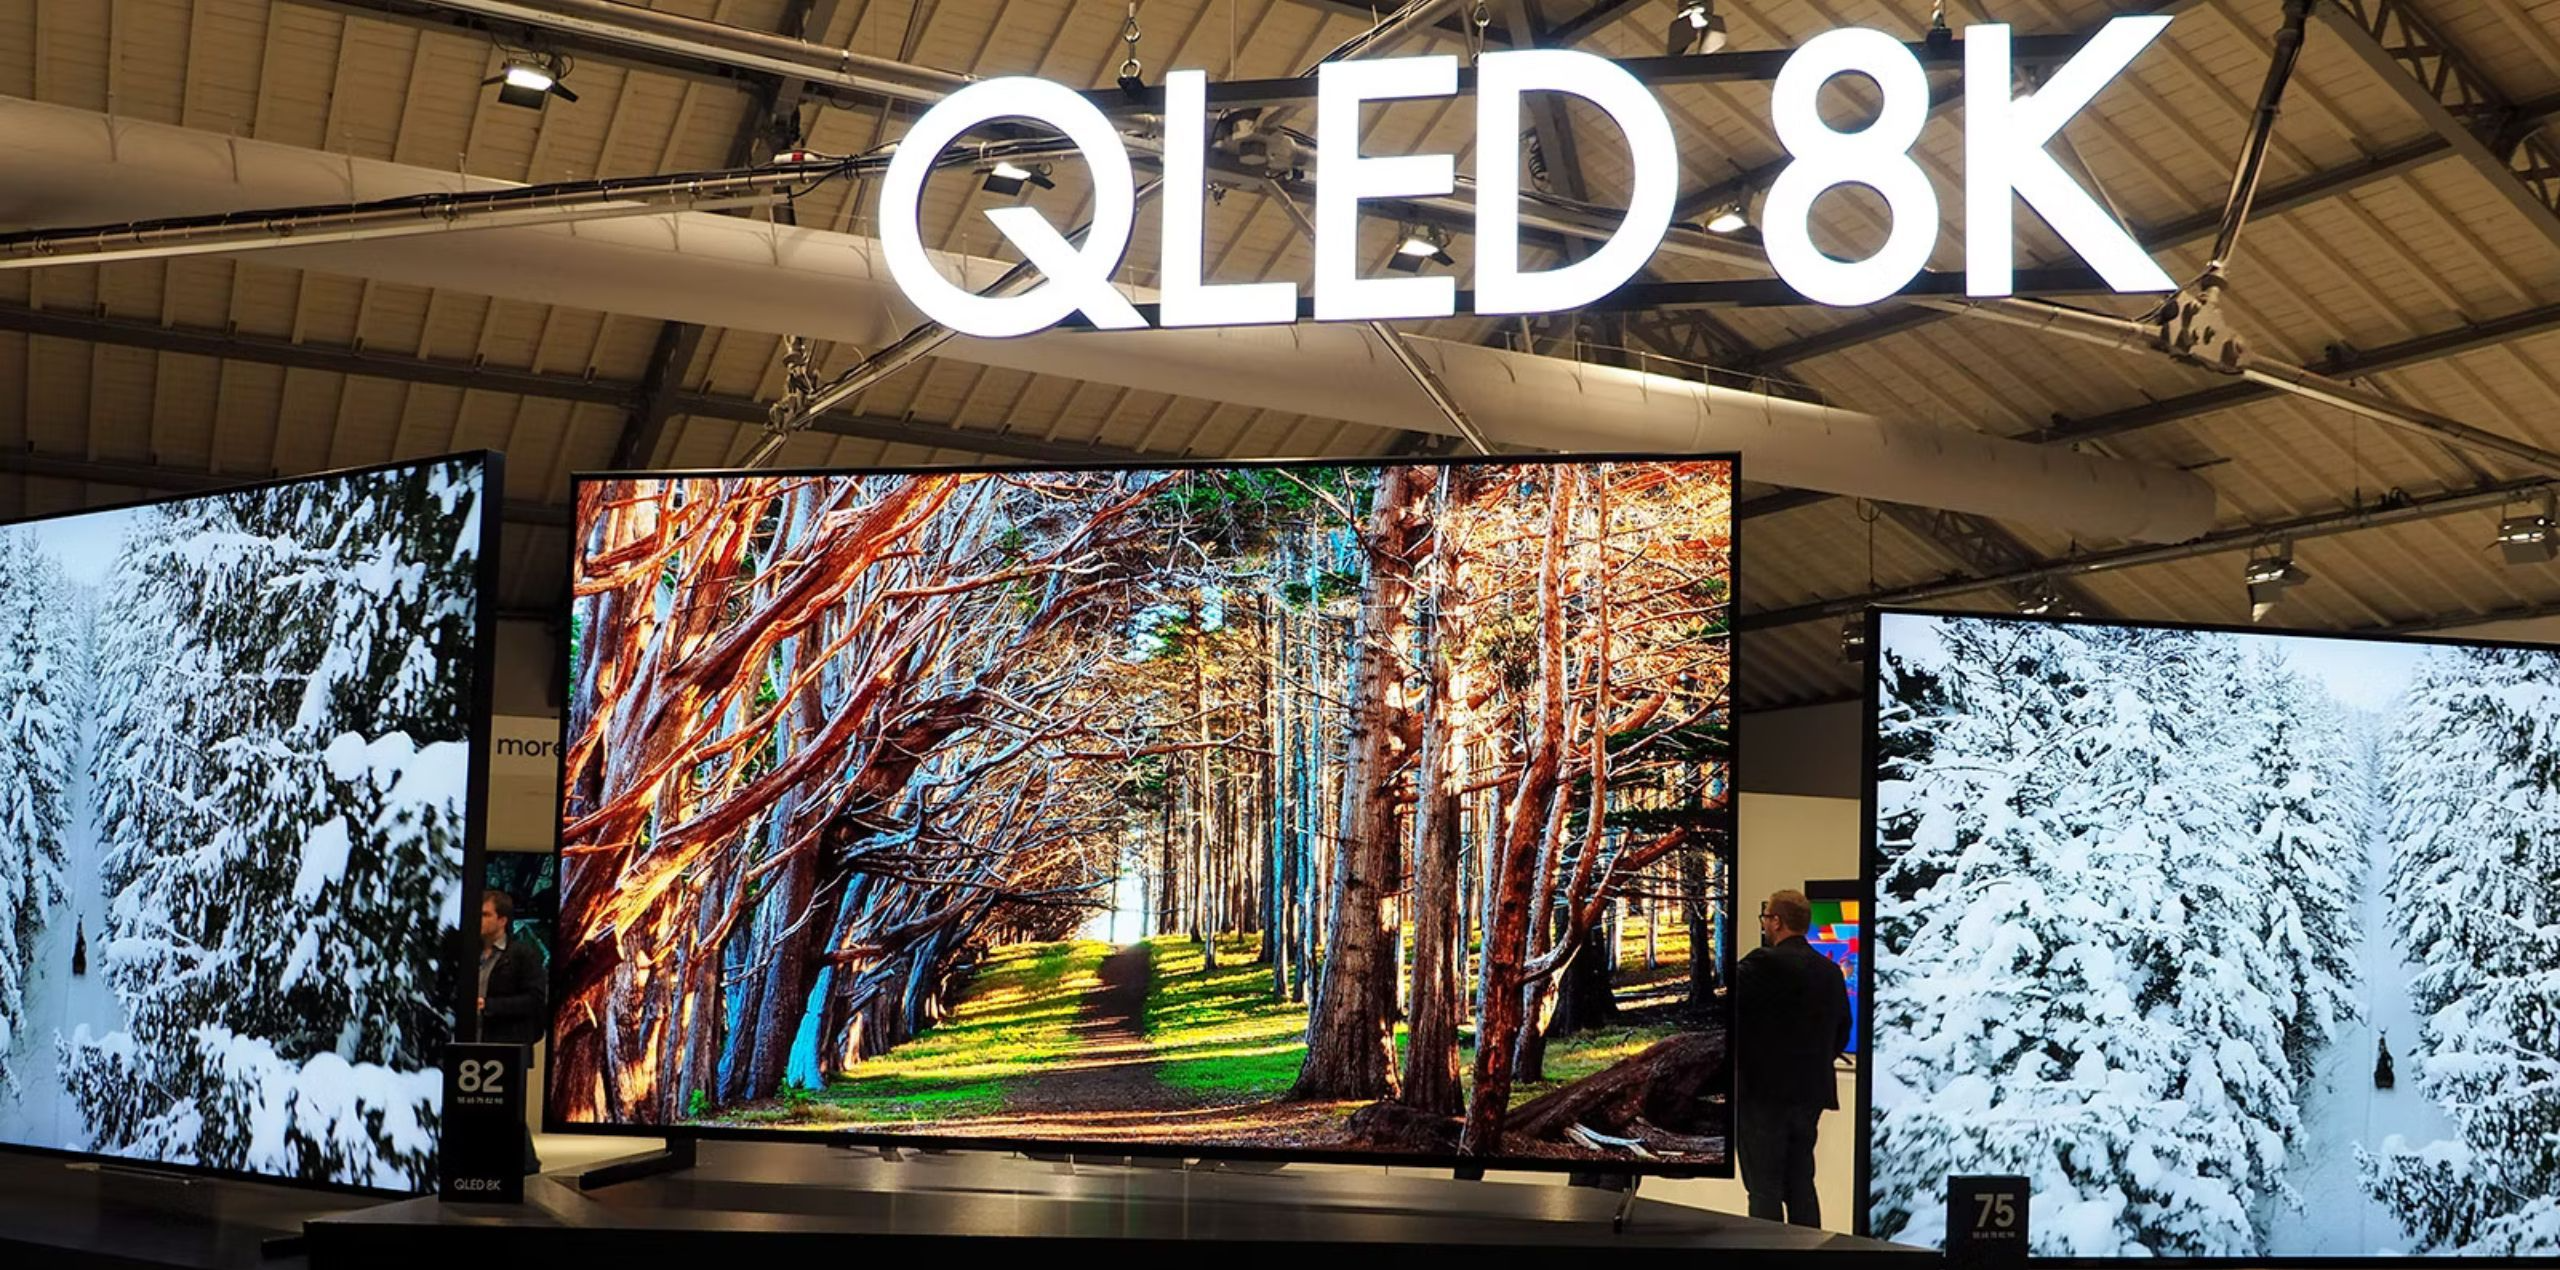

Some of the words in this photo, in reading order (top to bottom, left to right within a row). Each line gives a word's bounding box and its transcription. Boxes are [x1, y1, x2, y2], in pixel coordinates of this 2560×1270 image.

[878, 49, 1678, 338] QLED
[1762, 15, 2178, 307] 8K
[459, 1060, 503, 1092] 82
[454, 1178, 485, 1190] QLED
[486, 1179, 501, 1190] 8K
[1975, 1194, 2014, 1227] 75
